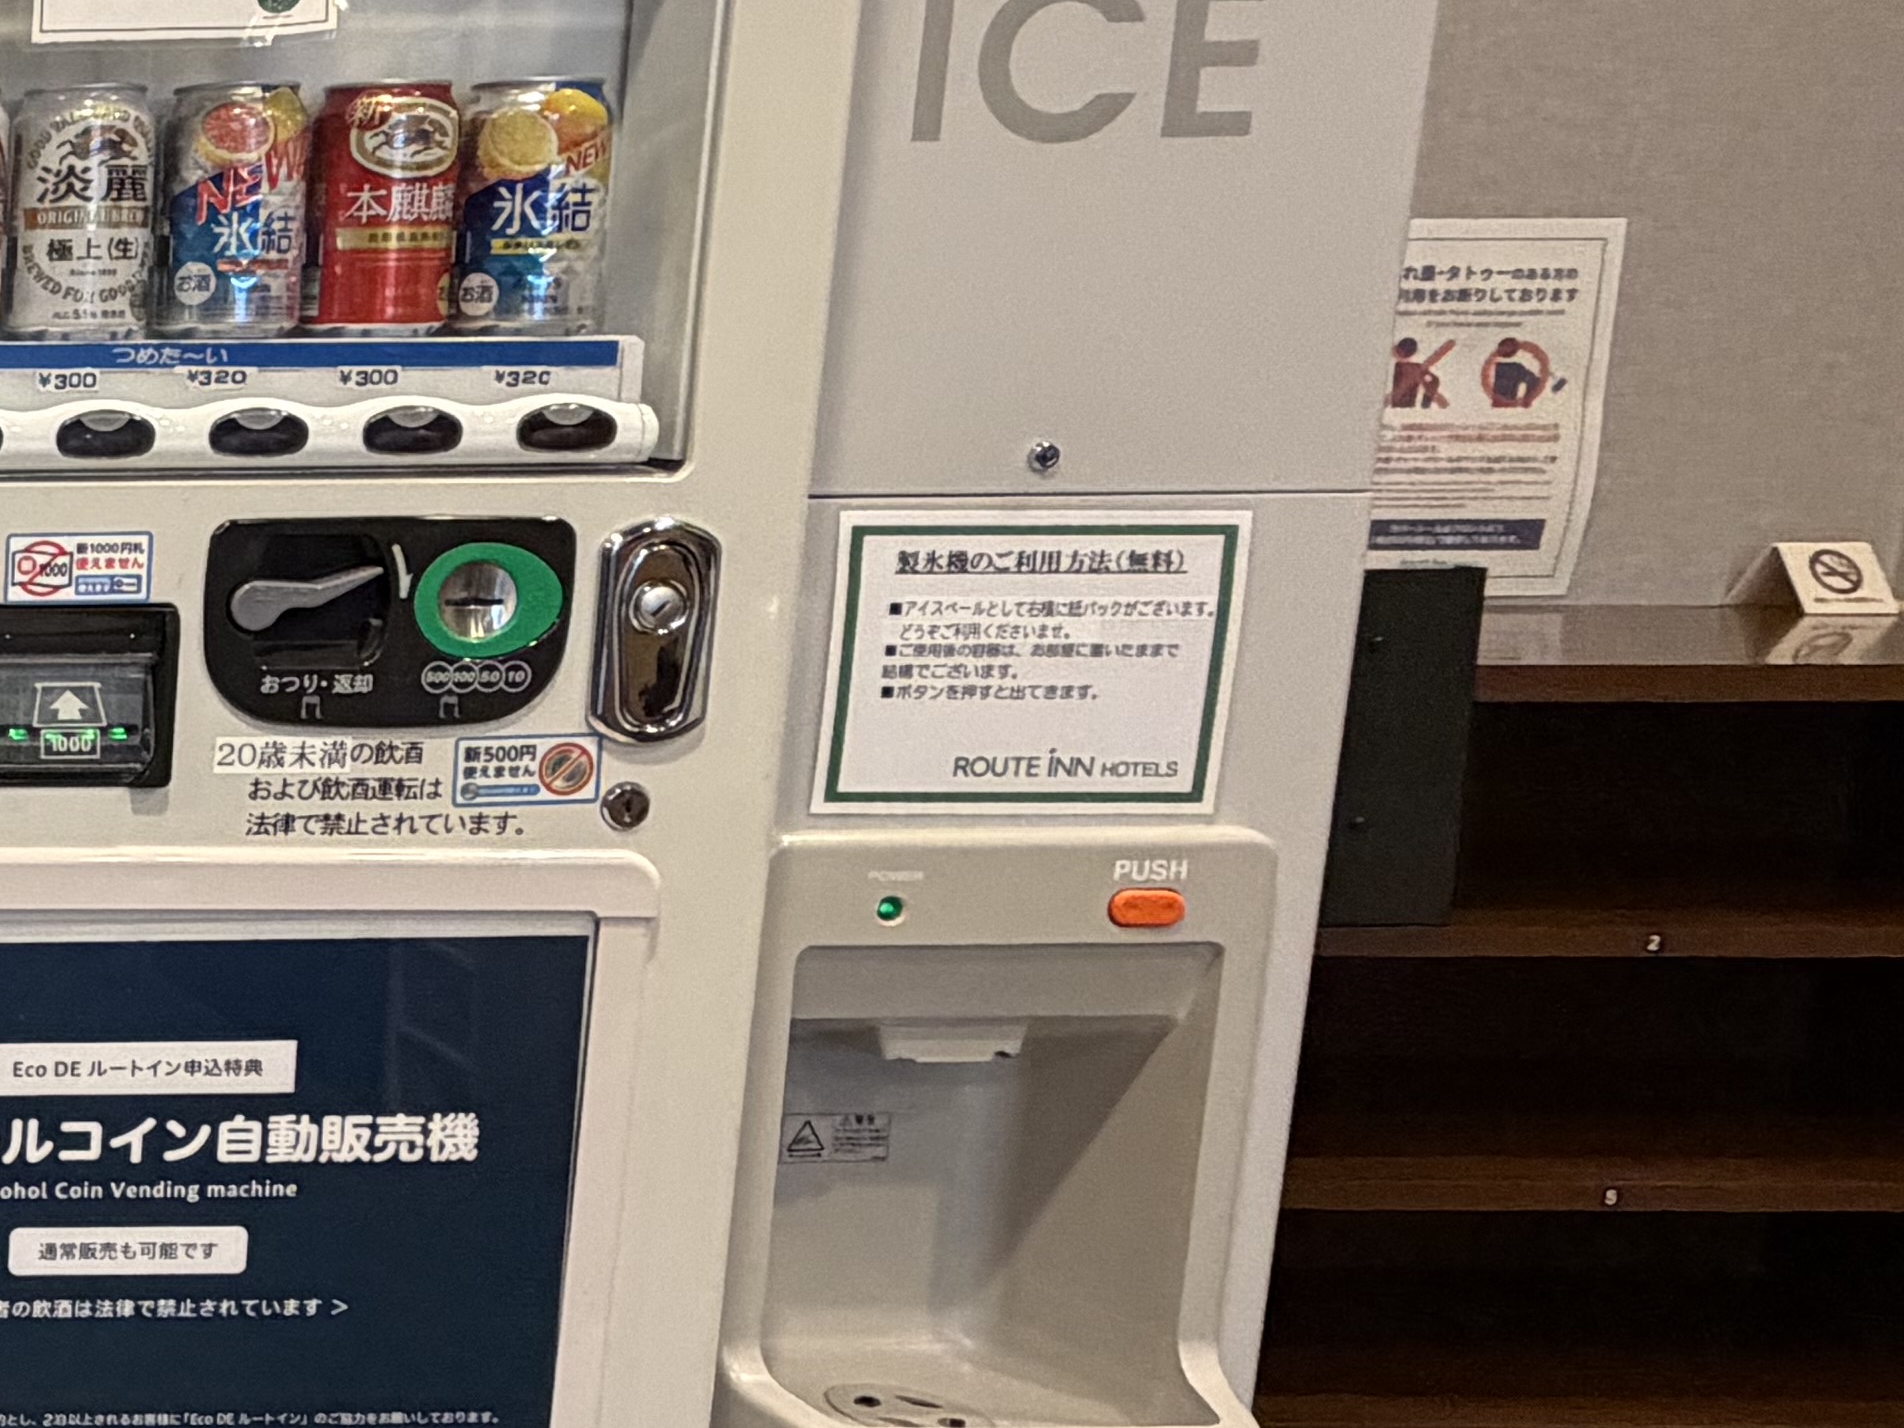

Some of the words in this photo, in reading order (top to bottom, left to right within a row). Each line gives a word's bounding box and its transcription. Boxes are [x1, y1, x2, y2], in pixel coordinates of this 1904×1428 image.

[35, 163, 149, 204] 淡麗
[344, 182, 455, 225] 本麒麟
[211, 210, 295, 257] 氷結
[175, 273, 212, 293] お酒
[38, 373, 98, 389] ¥300
[339, 369, 399, 386] ¥300
[76, 557, 144, 570] 使えません
[895, 548, 1188, 574] 製氷機のご利用方法(無料)
[899, 622, 1072, 640] どうぞご利用くださいませ。
[260, 674, 374, 695] おつり・返却
[51, 736, 92, 752] 1000
[217, 740, 425, 770] 20歳未満の飲酒
[464, 744, 537, 764] 新500円
[463, 765, 536, 780] 使えません
[952, 755, 1041, 778] ROUTE
[1101, 760, 1180, 778] HOTELS
[248, 777, 443, 802] および飲酒運転は
[245, 811, 526, 837] 法律で禁止されています。
[1113, 859, 1189, 882] PUSH
[12, 1059, 48, 1079] Eco
[53, 1058, 82, 1078] DE
[88, 1057, 265, 1080] ルートイン申込特典
[53, 1179, 105, 1200] Coin
[109, 1178, 201, 1204] Vending
[206, 1178, 298, 1199] machine
[37, 1239, 220, 1263] 通常販売も可能です
